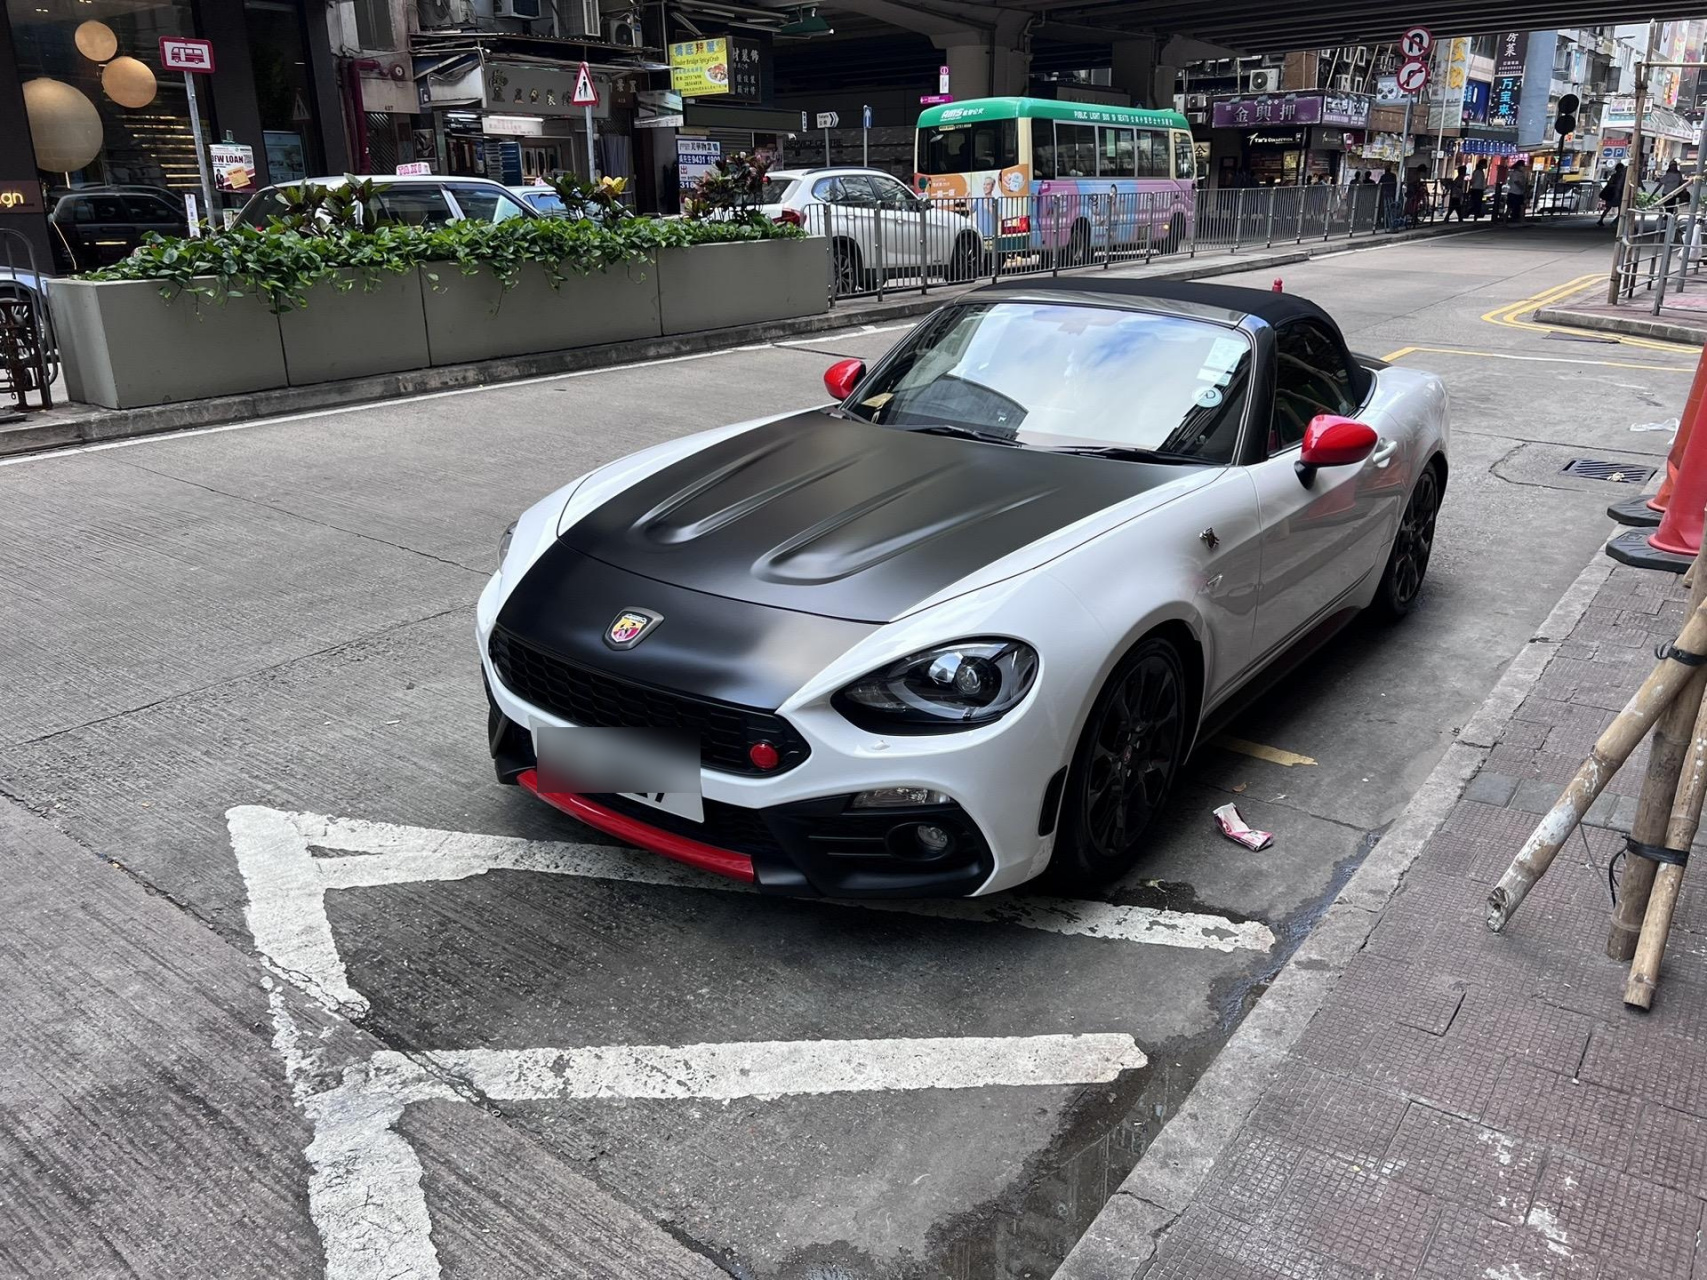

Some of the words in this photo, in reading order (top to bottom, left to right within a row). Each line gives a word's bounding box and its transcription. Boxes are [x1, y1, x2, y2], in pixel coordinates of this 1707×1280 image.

[1073, 110, 1088, 120] PUBLIC
[1089, 112, 1101, 120] LIGHT
[1102, 113, 1110, 121] BUS
[225, 155, 244, 164] LOAN
[397, 163, 422, 175] TAXI
